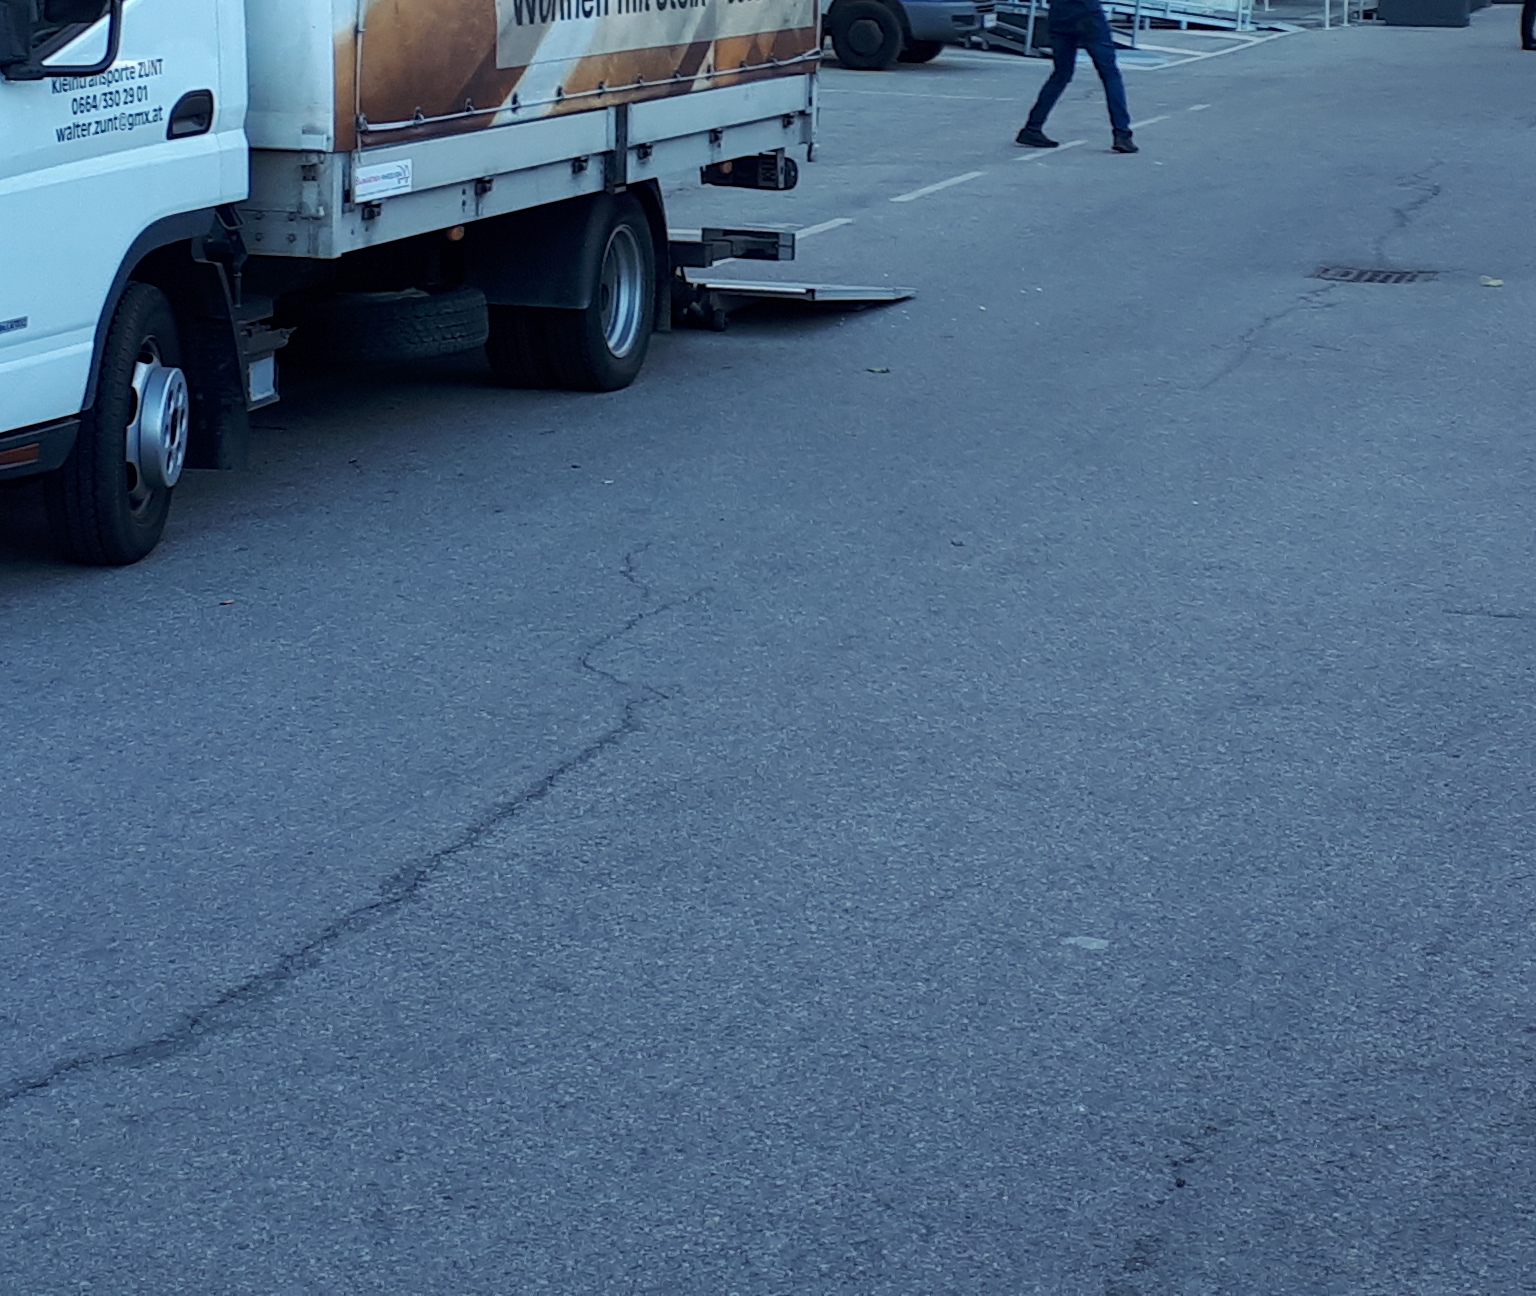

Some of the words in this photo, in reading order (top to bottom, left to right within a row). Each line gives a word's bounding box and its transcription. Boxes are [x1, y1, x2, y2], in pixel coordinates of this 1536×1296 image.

[138, 58, 163, 79] ZUNT
[71, 88, 120, 116] 0664/330
[123, 87, 135, 106] 29
[137, 84, 149, 103] 01
[56, 105, 164, 143] walter.zunt@gmx.at
